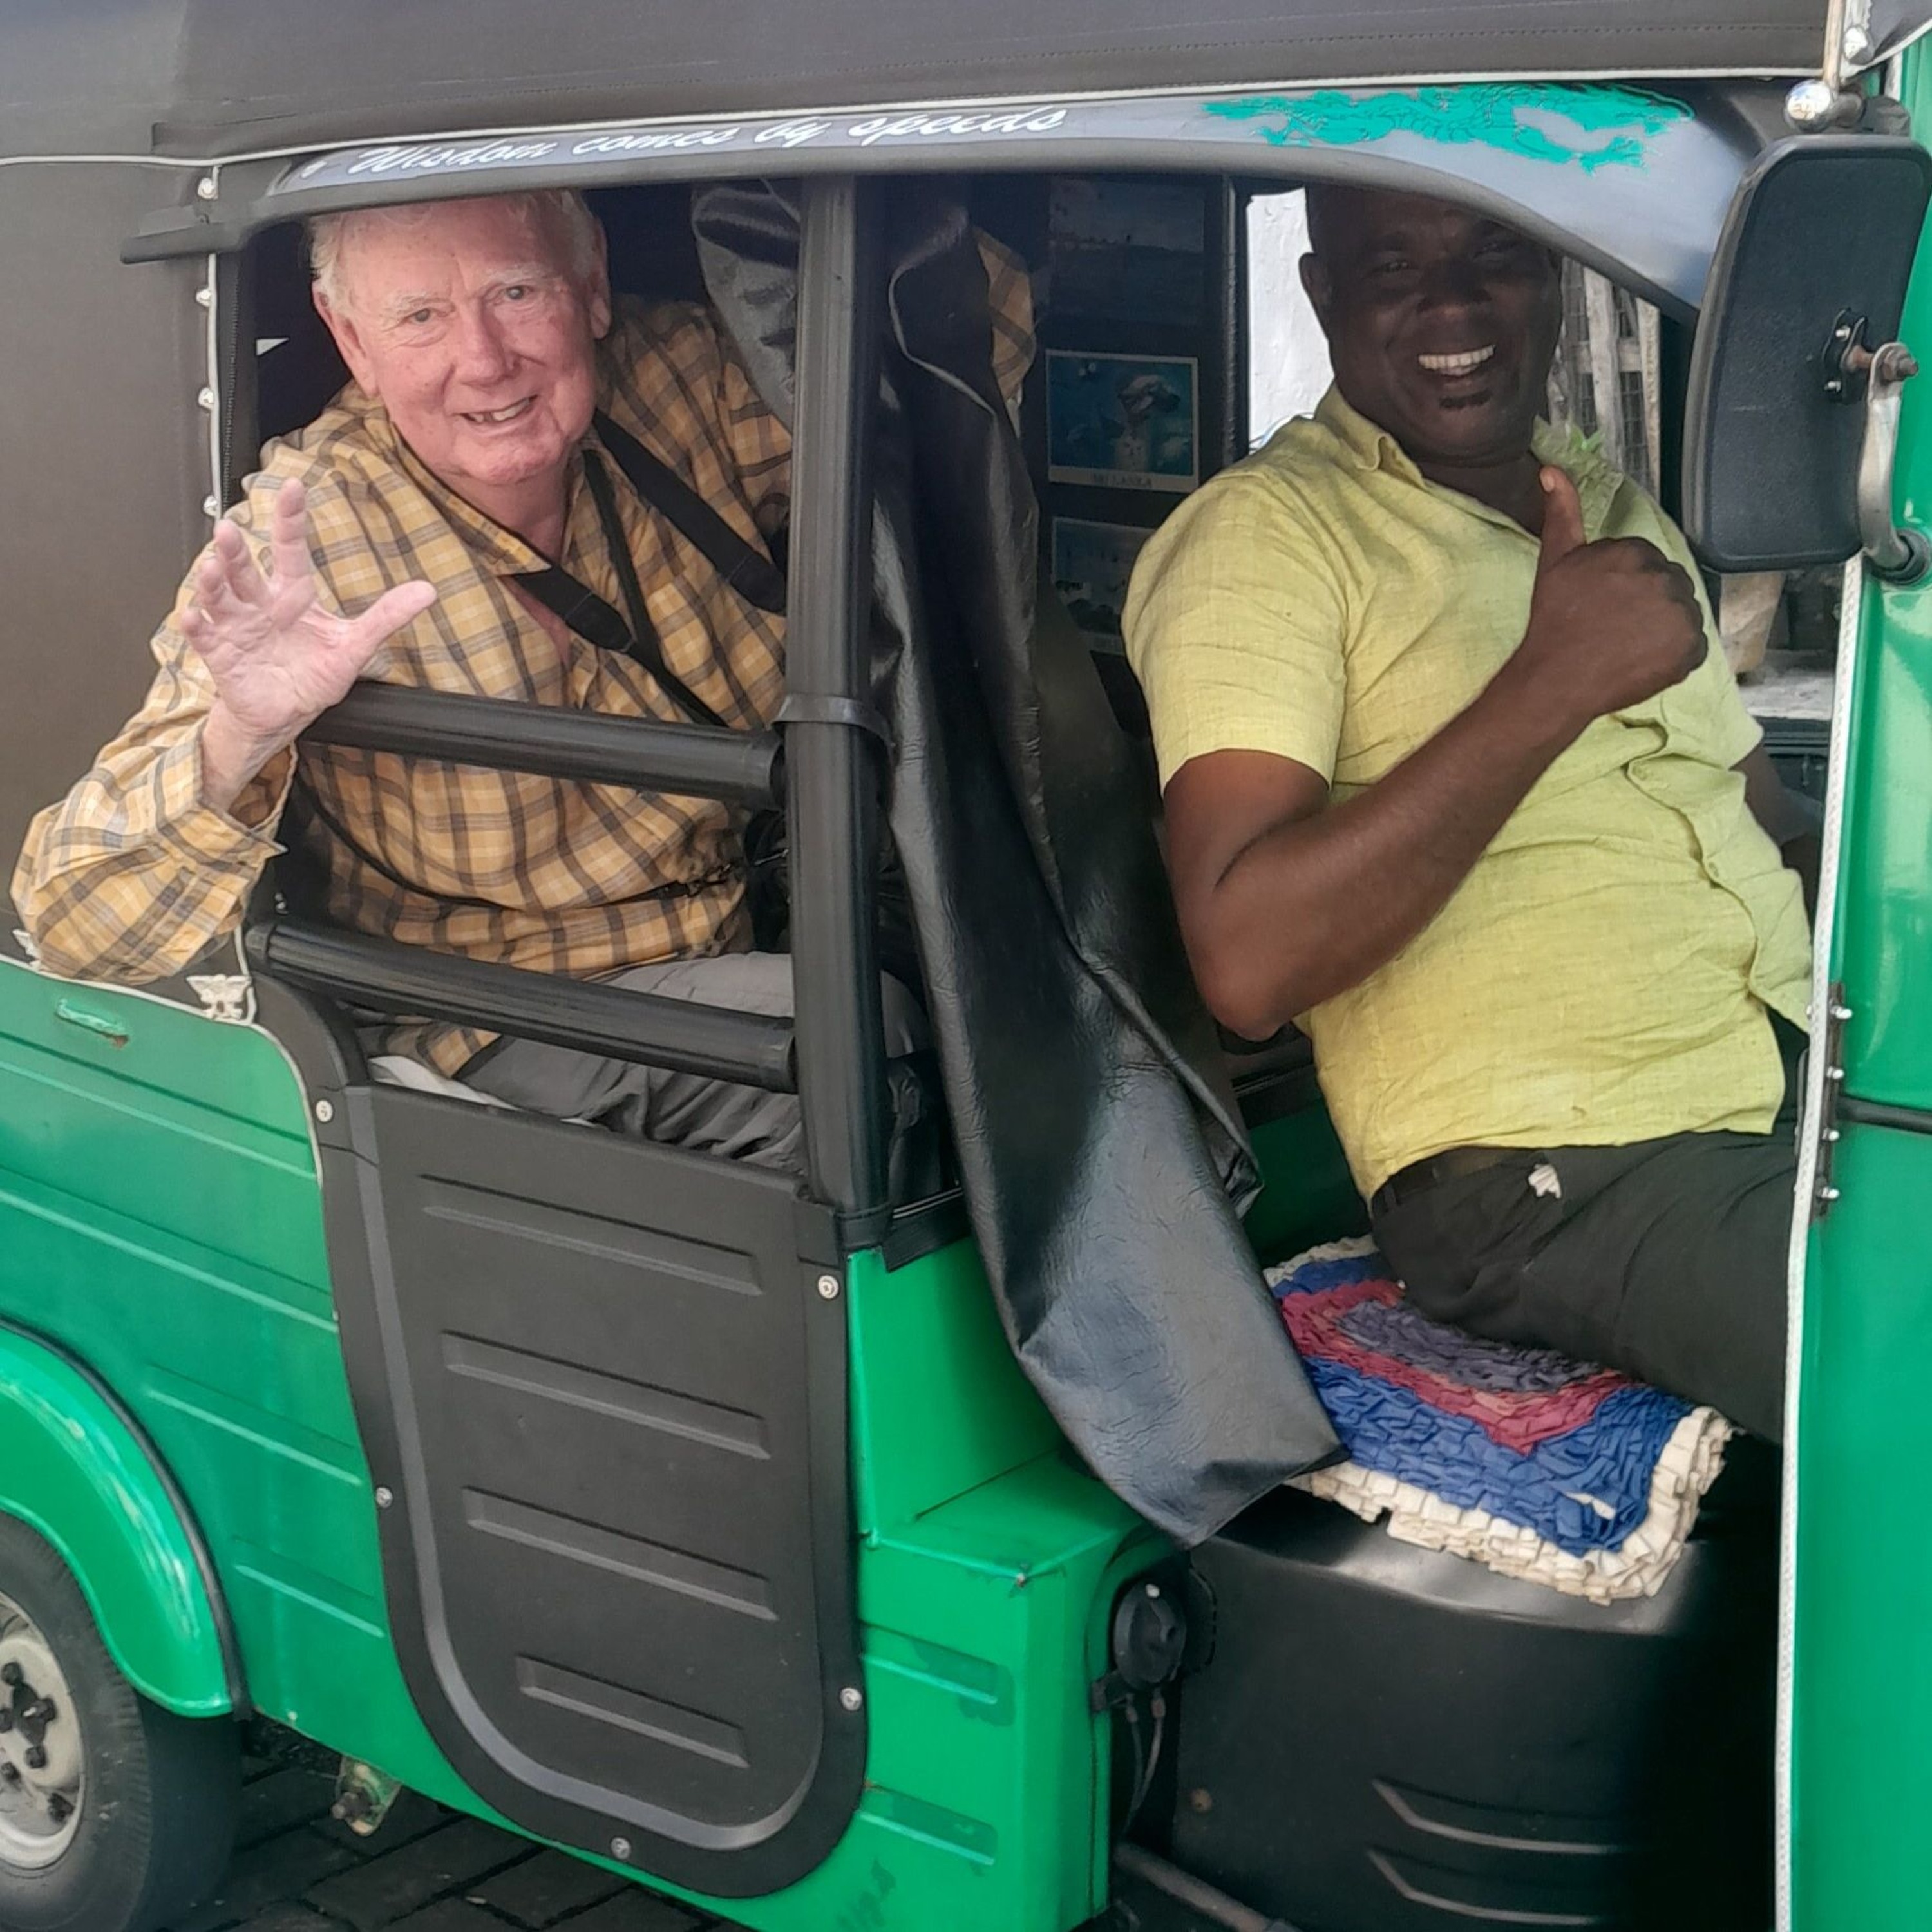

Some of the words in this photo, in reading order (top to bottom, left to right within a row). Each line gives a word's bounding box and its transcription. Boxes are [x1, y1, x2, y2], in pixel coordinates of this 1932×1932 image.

[348, 140, 557, 174] Wisdom
[572, 128, 740, 155] comes
[754, 116, 833, 148] by
[848, 106, 1067, 146] speeds
